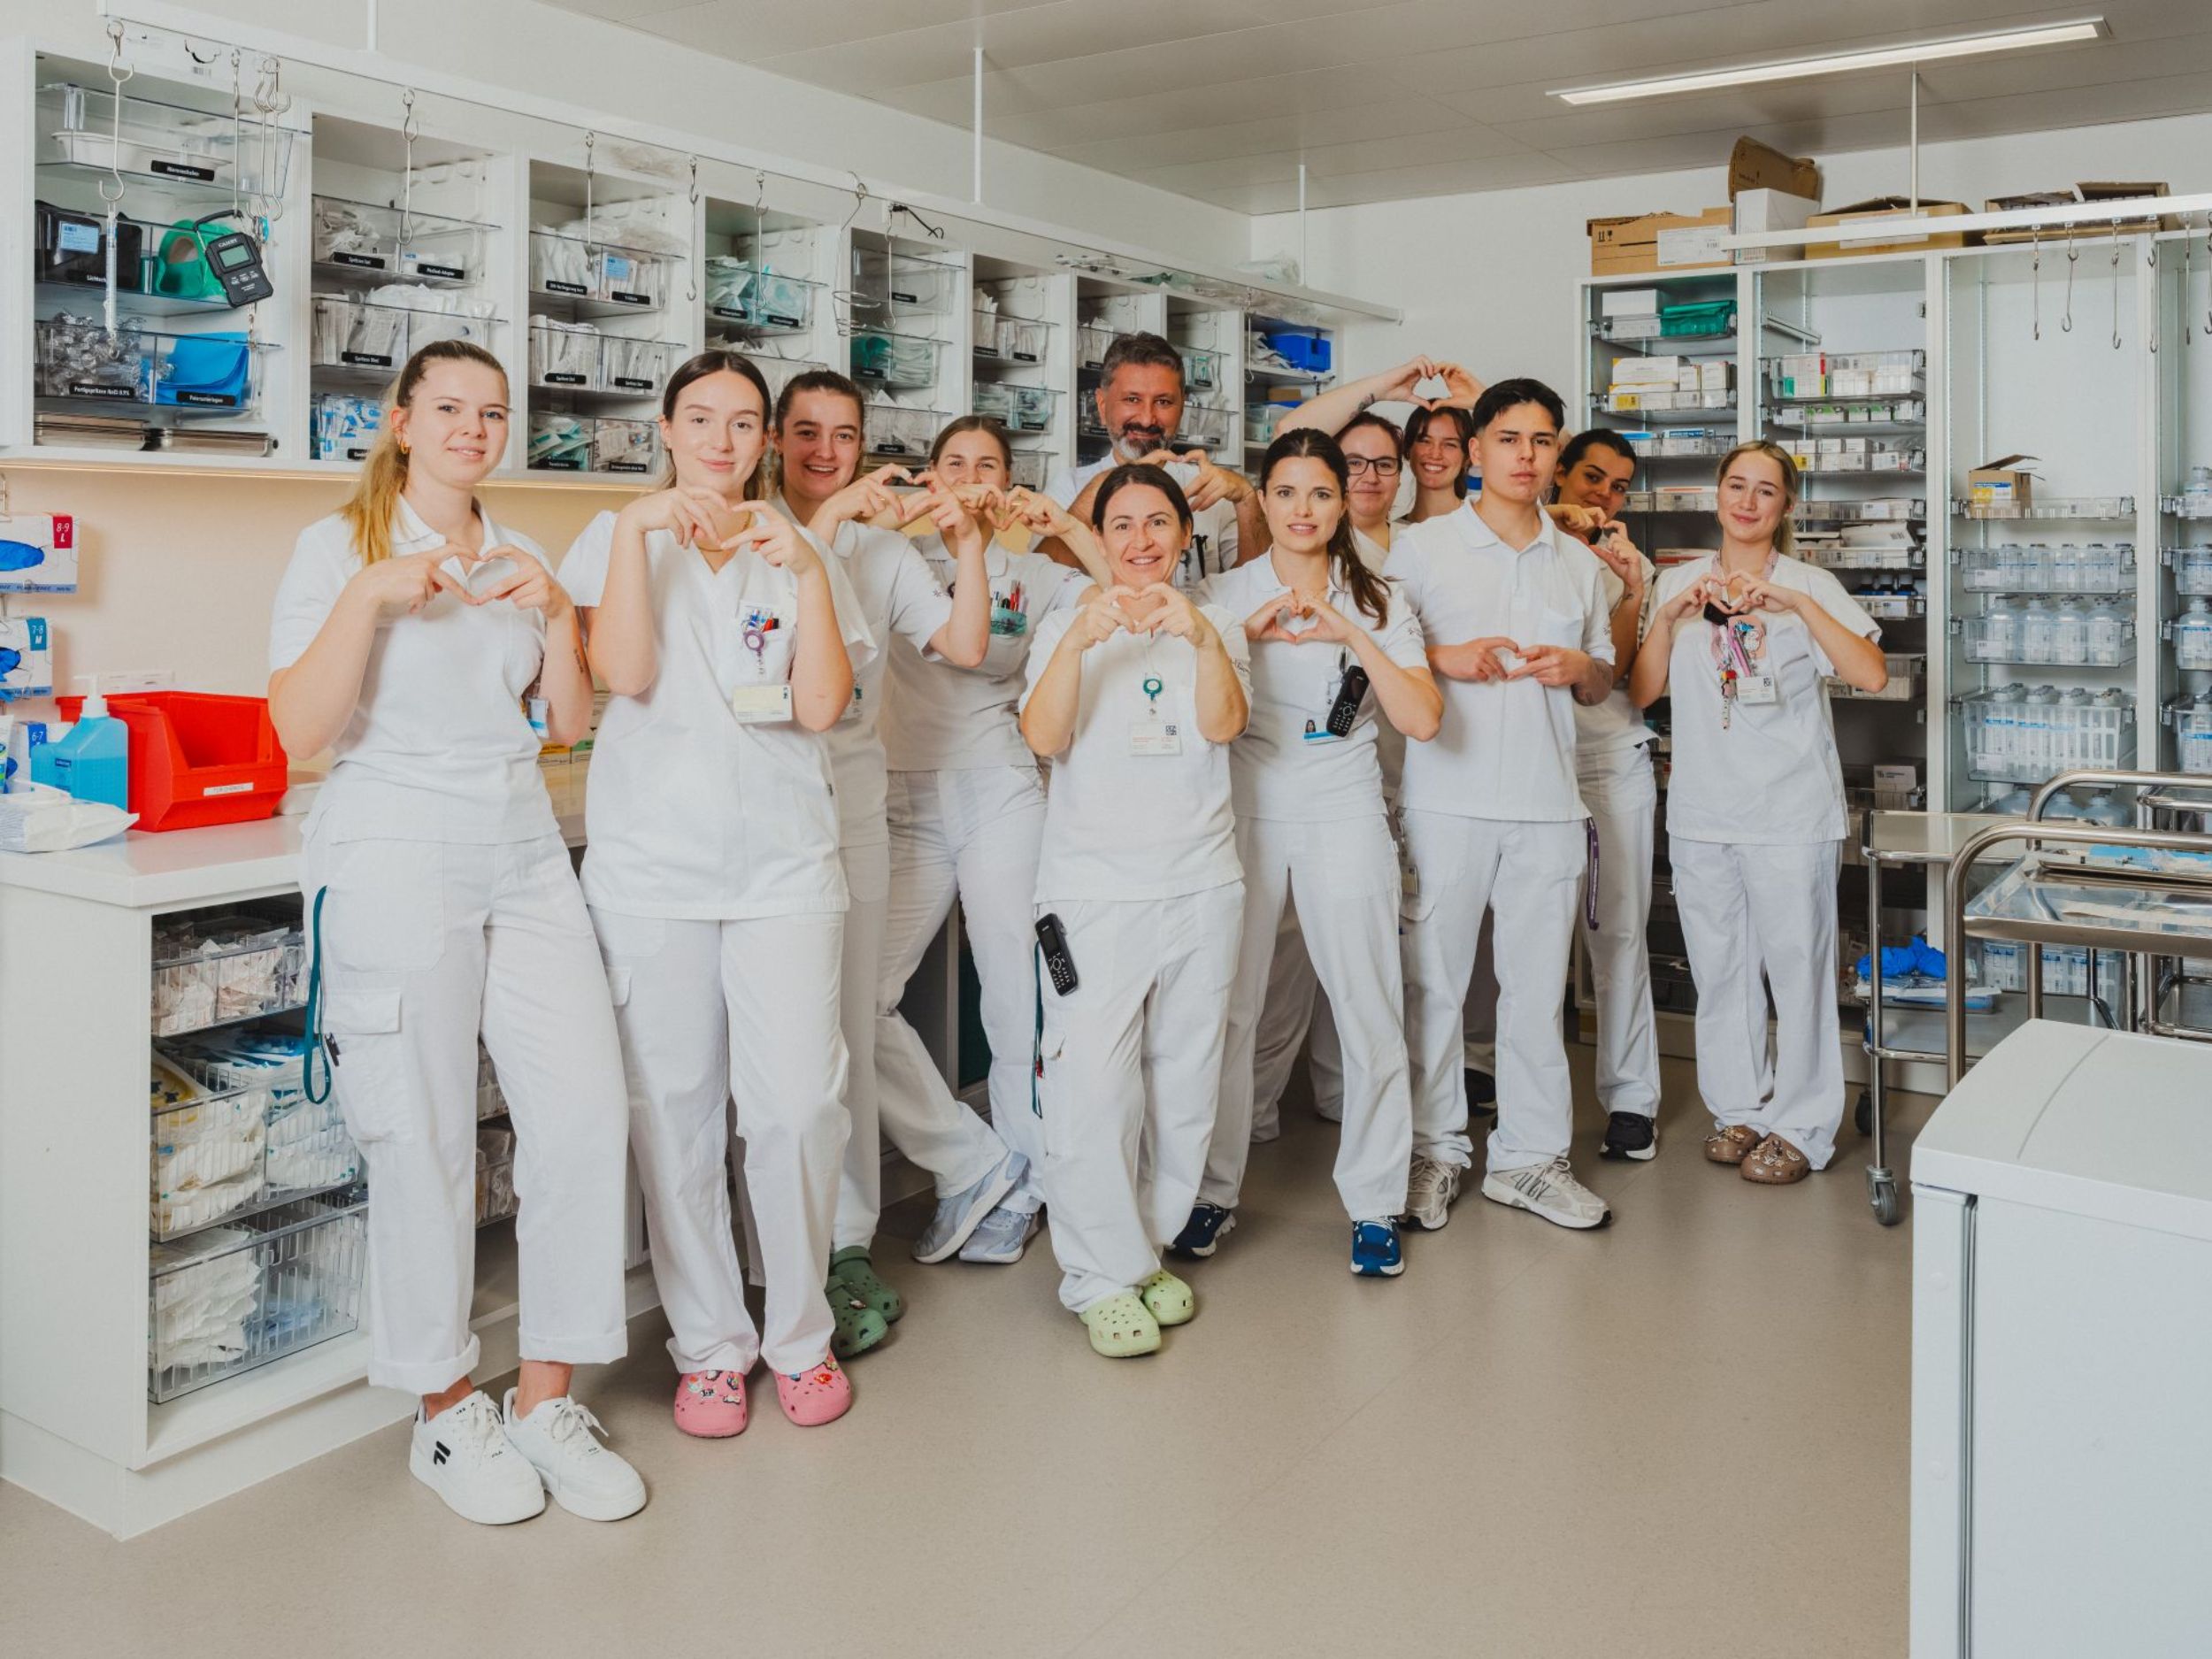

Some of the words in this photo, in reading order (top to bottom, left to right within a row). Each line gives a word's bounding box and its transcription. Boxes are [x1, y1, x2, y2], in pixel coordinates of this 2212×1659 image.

[56, 522, 70, 533] 8-9
[60, 533, 65, 542] L
[32, 625, 44, 634] 7-8
[35, 635, 42, 644] M
[31, 731, 44, 741] 6-7
